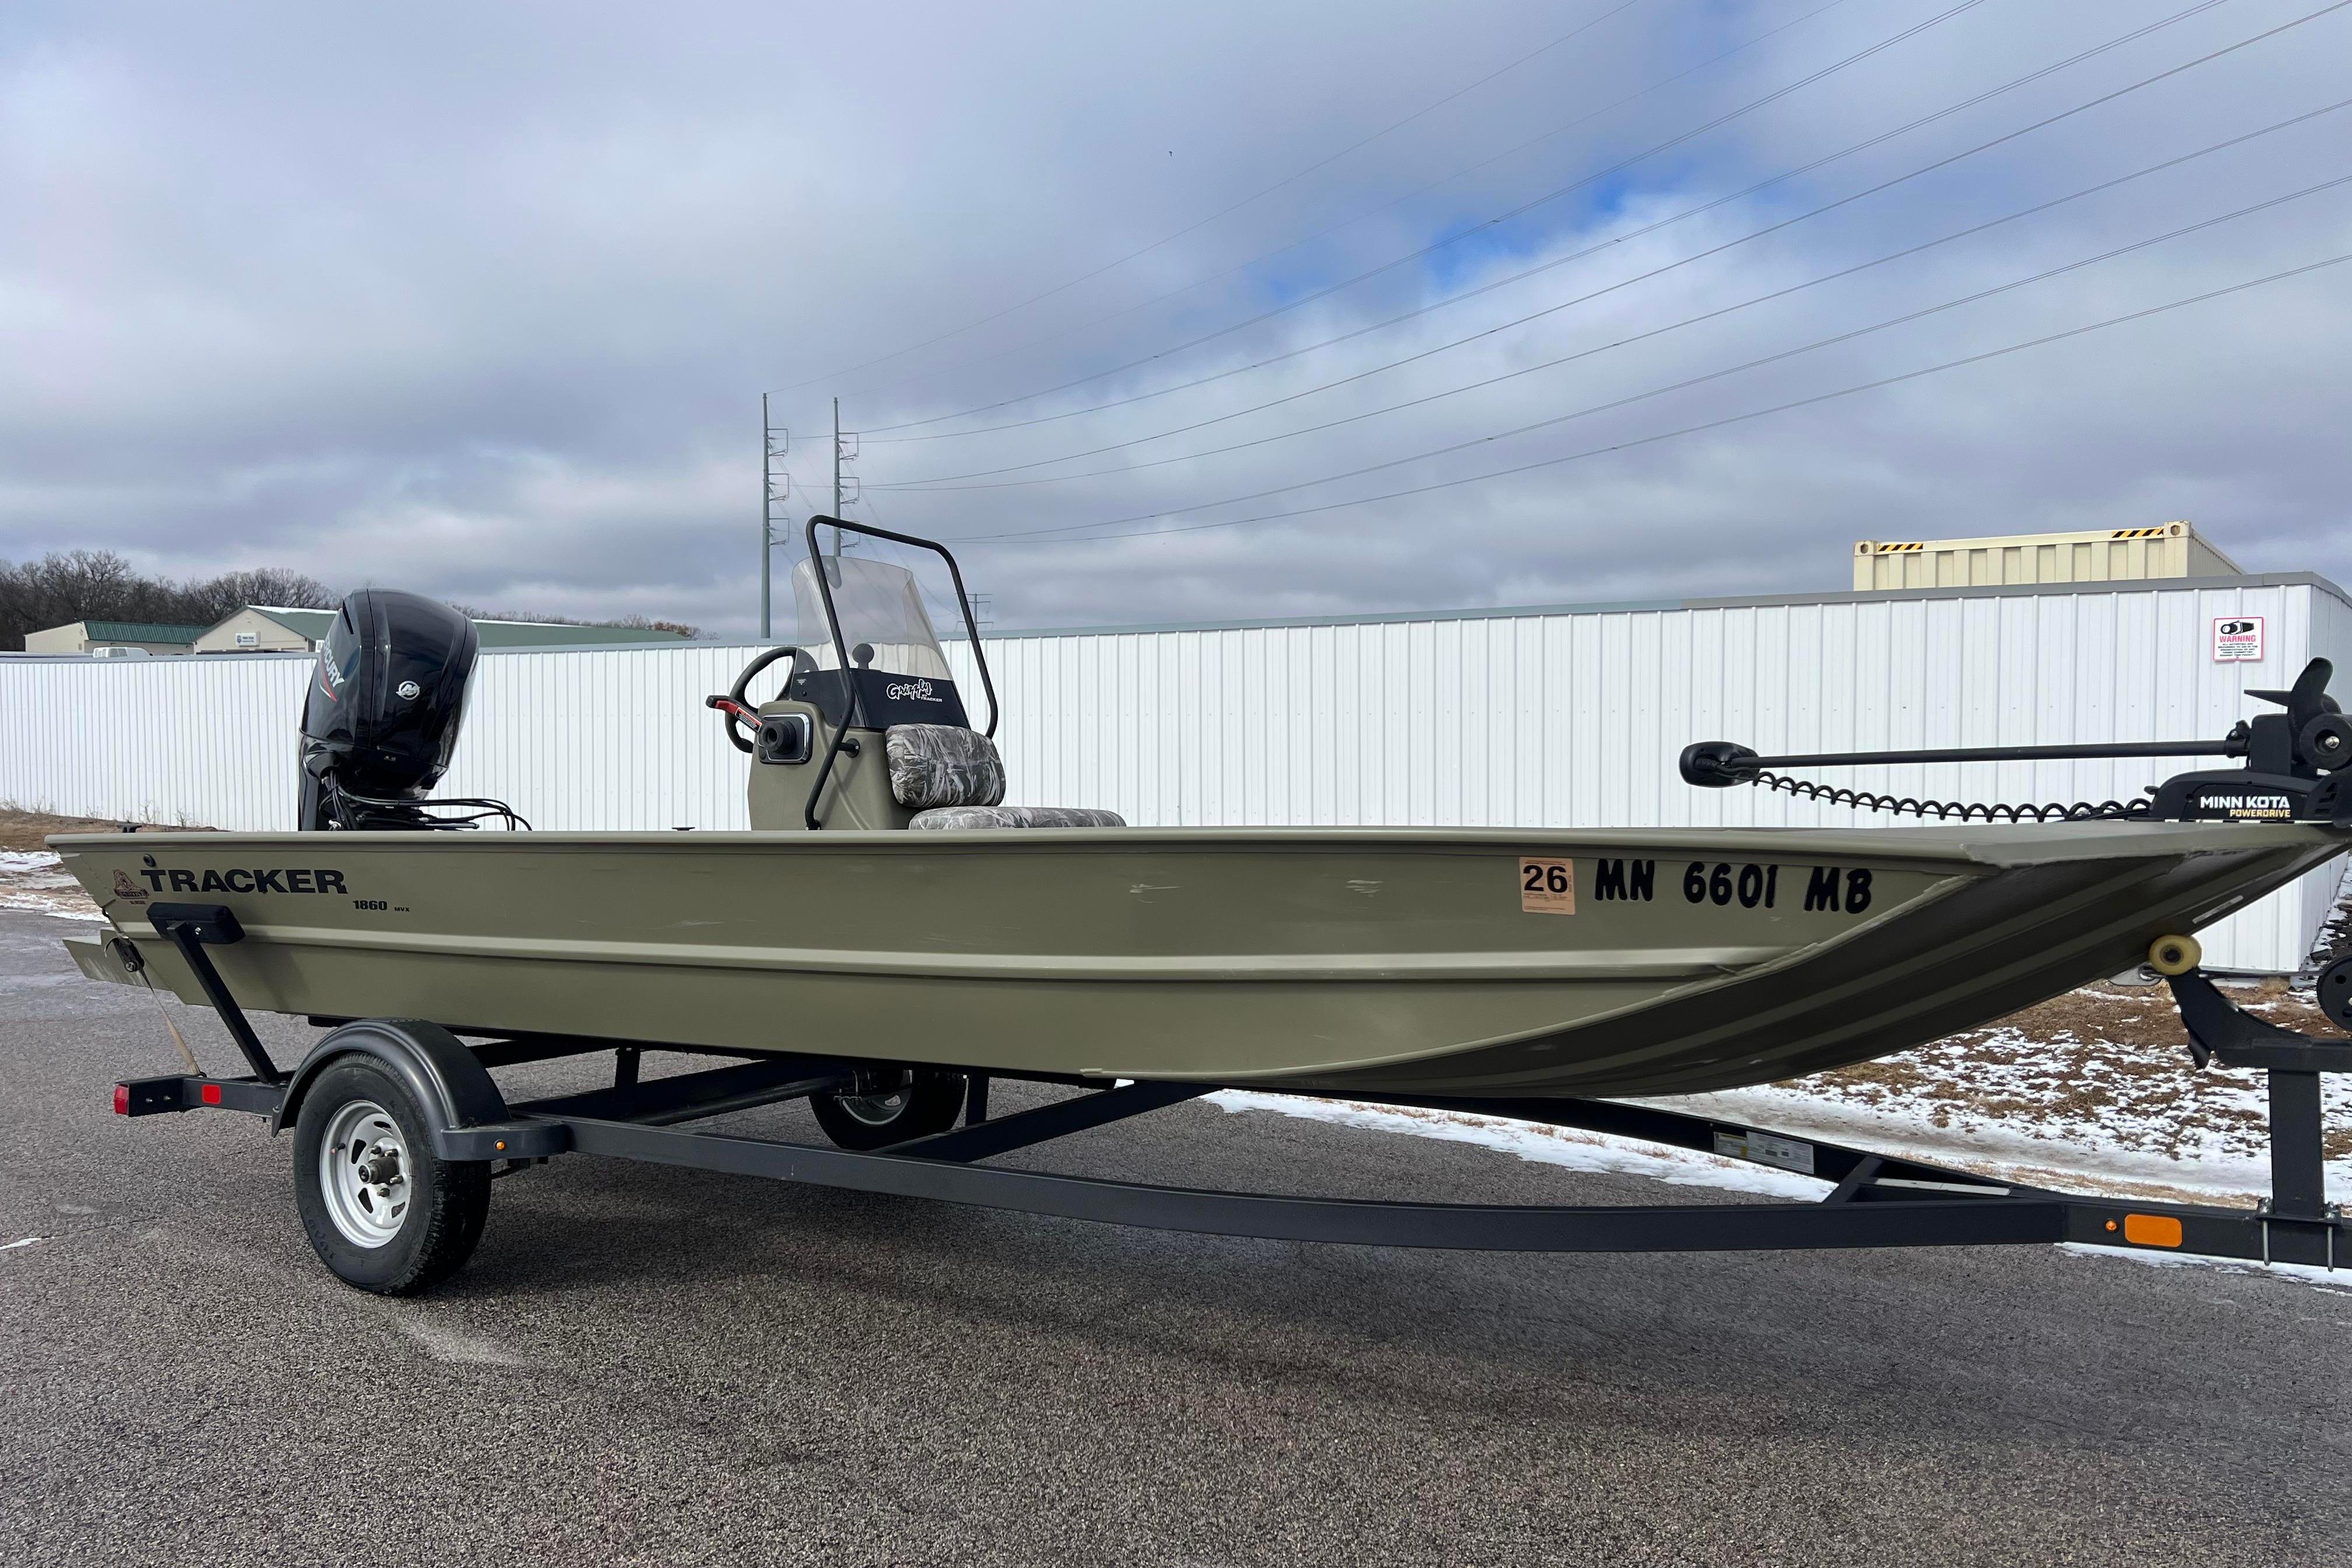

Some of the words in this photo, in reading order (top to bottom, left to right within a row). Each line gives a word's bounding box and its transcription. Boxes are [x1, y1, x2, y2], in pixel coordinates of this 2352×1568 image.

[324, 634, 345, 687] RCURY
[886, 678, 933, 700] Grizzly
[2200, 796, 2243, 808] MINN
[2246, 796, 2290, 808] KOTA
[2230, 809, 2291, 817] POWERDRIVE
[140, 869, 349, 894] TRACKER
[1522, 864, 1568, 893] 26
[1594, 859, 1656, 902] MN
[1682, 861, 1779, 909] 6601
[1803, 866, 1873, 914] MB
[352, 900, 388, 911] 1860
